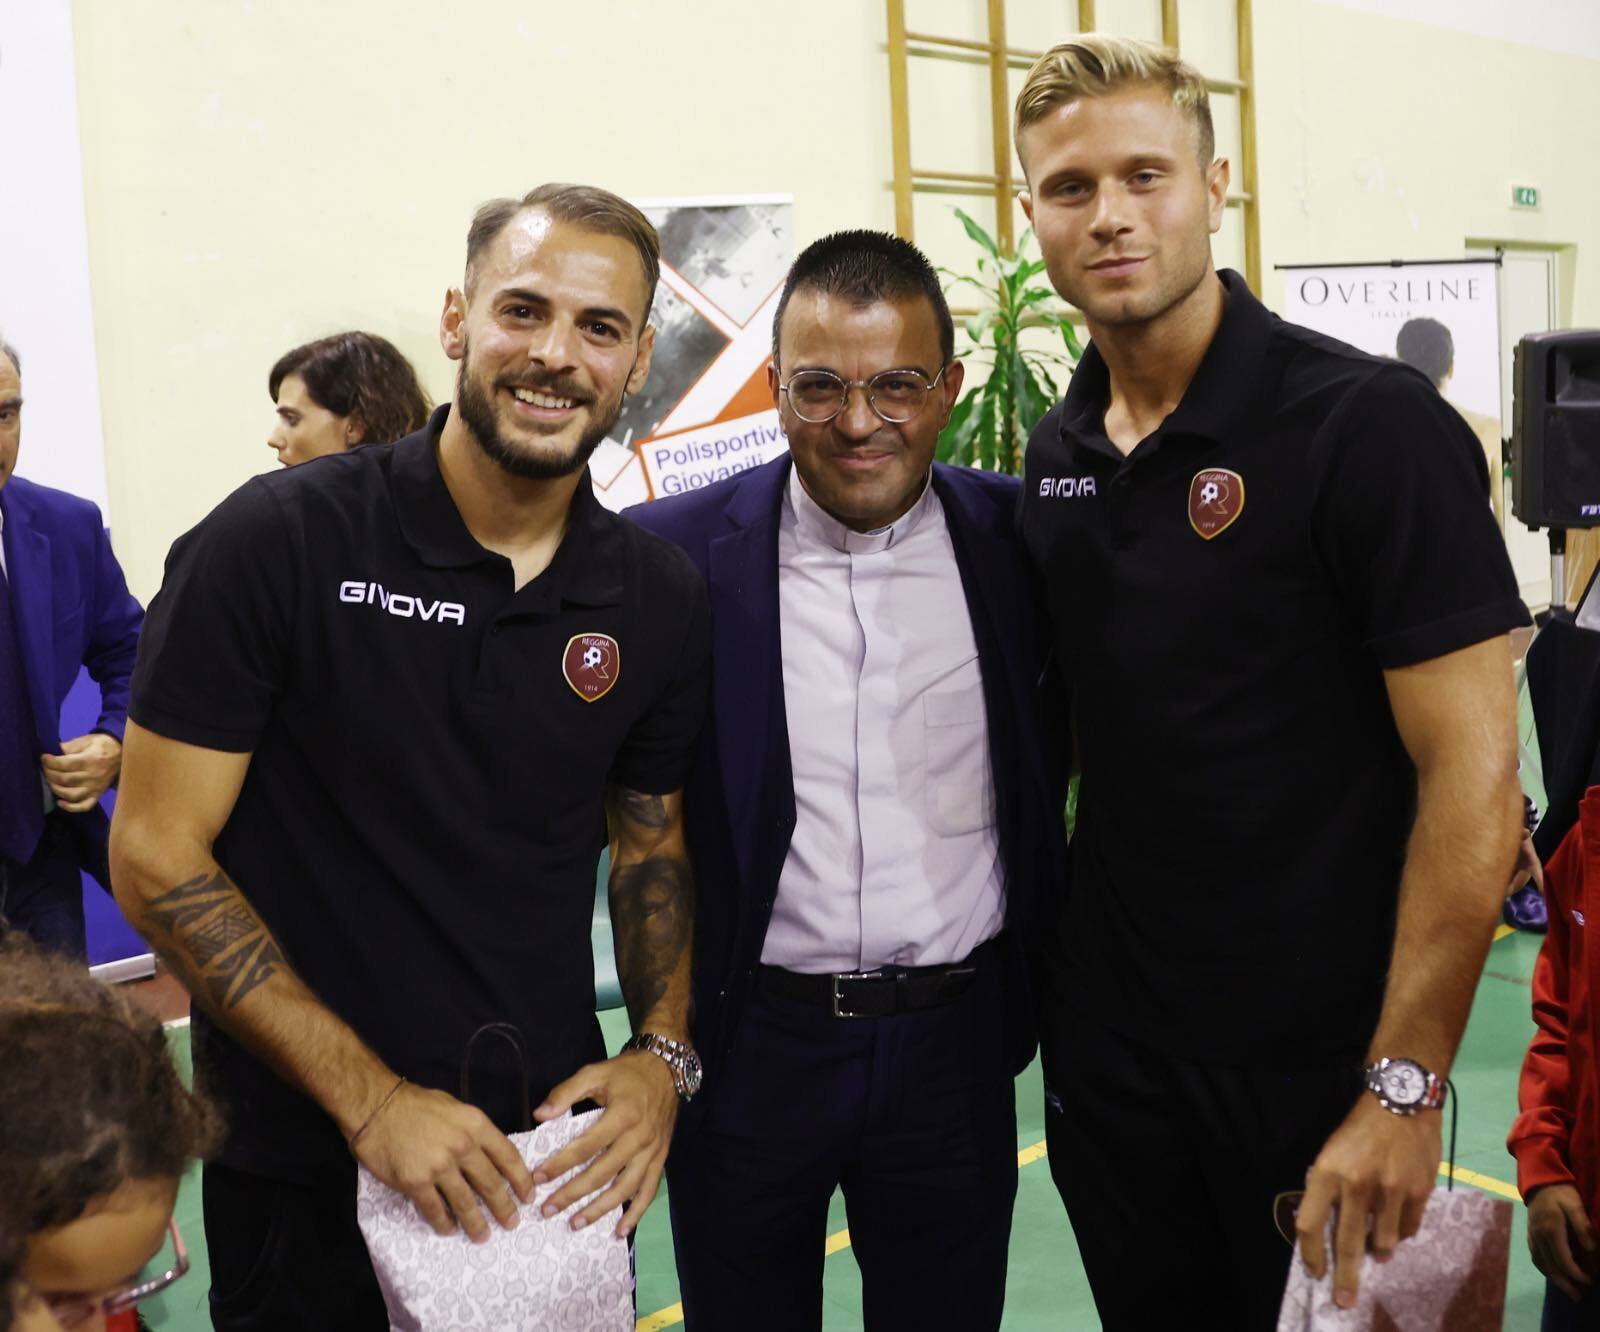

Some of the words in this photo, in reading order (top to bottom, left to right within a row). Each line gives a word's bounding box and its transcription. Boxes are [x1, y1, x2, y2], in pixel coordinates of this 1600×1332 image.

[1301, 277, 1481, 306] OVERLINE
[1039, 476, 1096, 498] GIVOVA
[339, 581, 465, 626] GIVOVA
[581, 637, 610, 647] REGGINA
